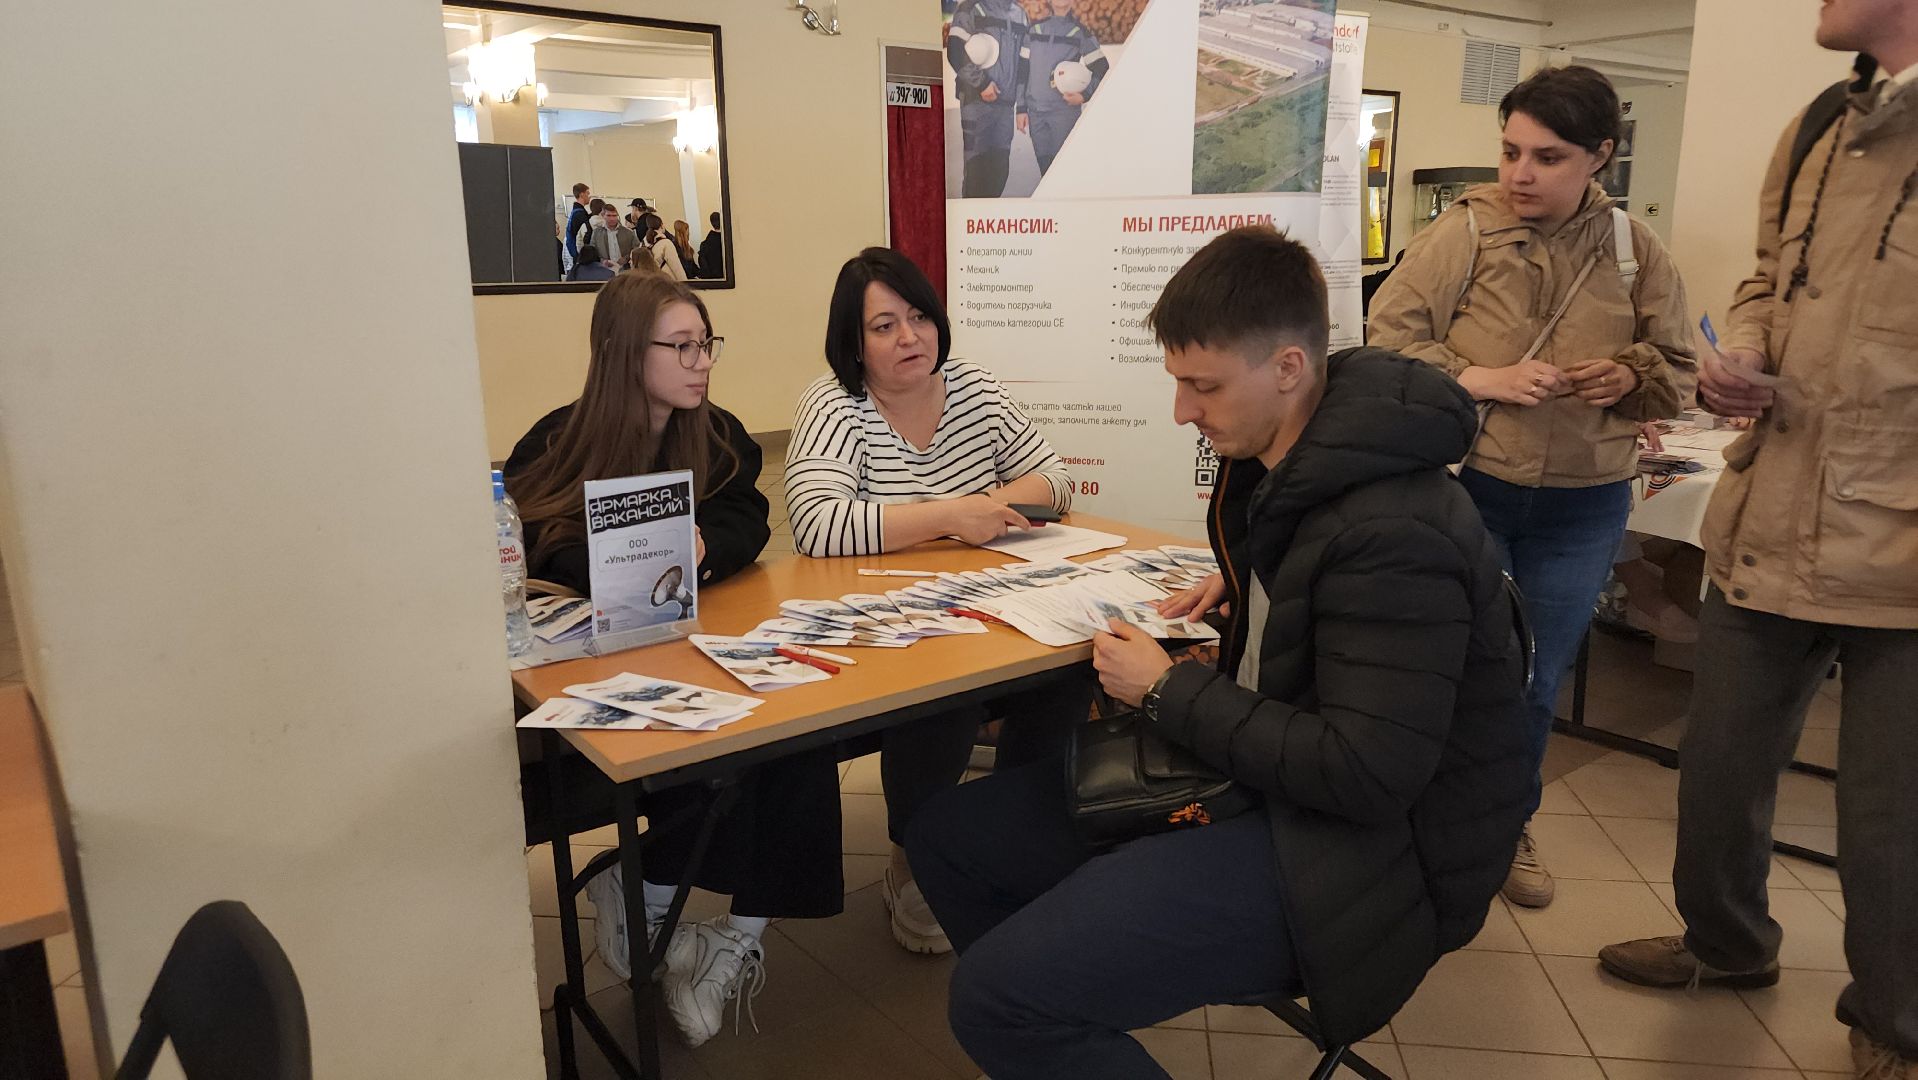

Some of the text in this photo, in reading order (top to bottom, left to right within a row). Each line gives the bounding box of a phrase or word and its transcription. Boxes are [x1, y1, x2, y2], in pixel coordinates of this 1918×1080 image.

[895, 86, 928, 105] 397-900
[966, 218, 1058, 234] ВАКАНСИИ:
[1122, 217, 1153, 233] МЫ
[966, 246, 1033, 258] Оператор линии
[1121, 245, 1184, 257] Конкурентную
[966, 264, 1000, 274] Механик
[1121, 264, 1156, 274] Премию
[1157, 265, 1169, 273] по
[966, 282, 1034, 294] Электромонтер
[966, 300, 1052, 312] Водитель погрузчика
[966, 317, 1006, 328] Водитель
[1007, 317, 1052, 328] категории
[1018, 401, 1122, 412] Вы стать частью нашей
[1057, 417, 1100, 426] заполните
[1101, 417, 1131, 427] анкету
[1133, 419, 1147, 427] для
[1059, 456, 1105, 466] tradecor.ru
[1080, 481, 1100, 496] 80
[589, 488, 672, 517] ЯРМАРКА
[591, 497, 684, 530] ВАКАНСИЙ
[628, 538, 648, 549] ООО
[604, 549, 675, 564] «Ультрадекор»
